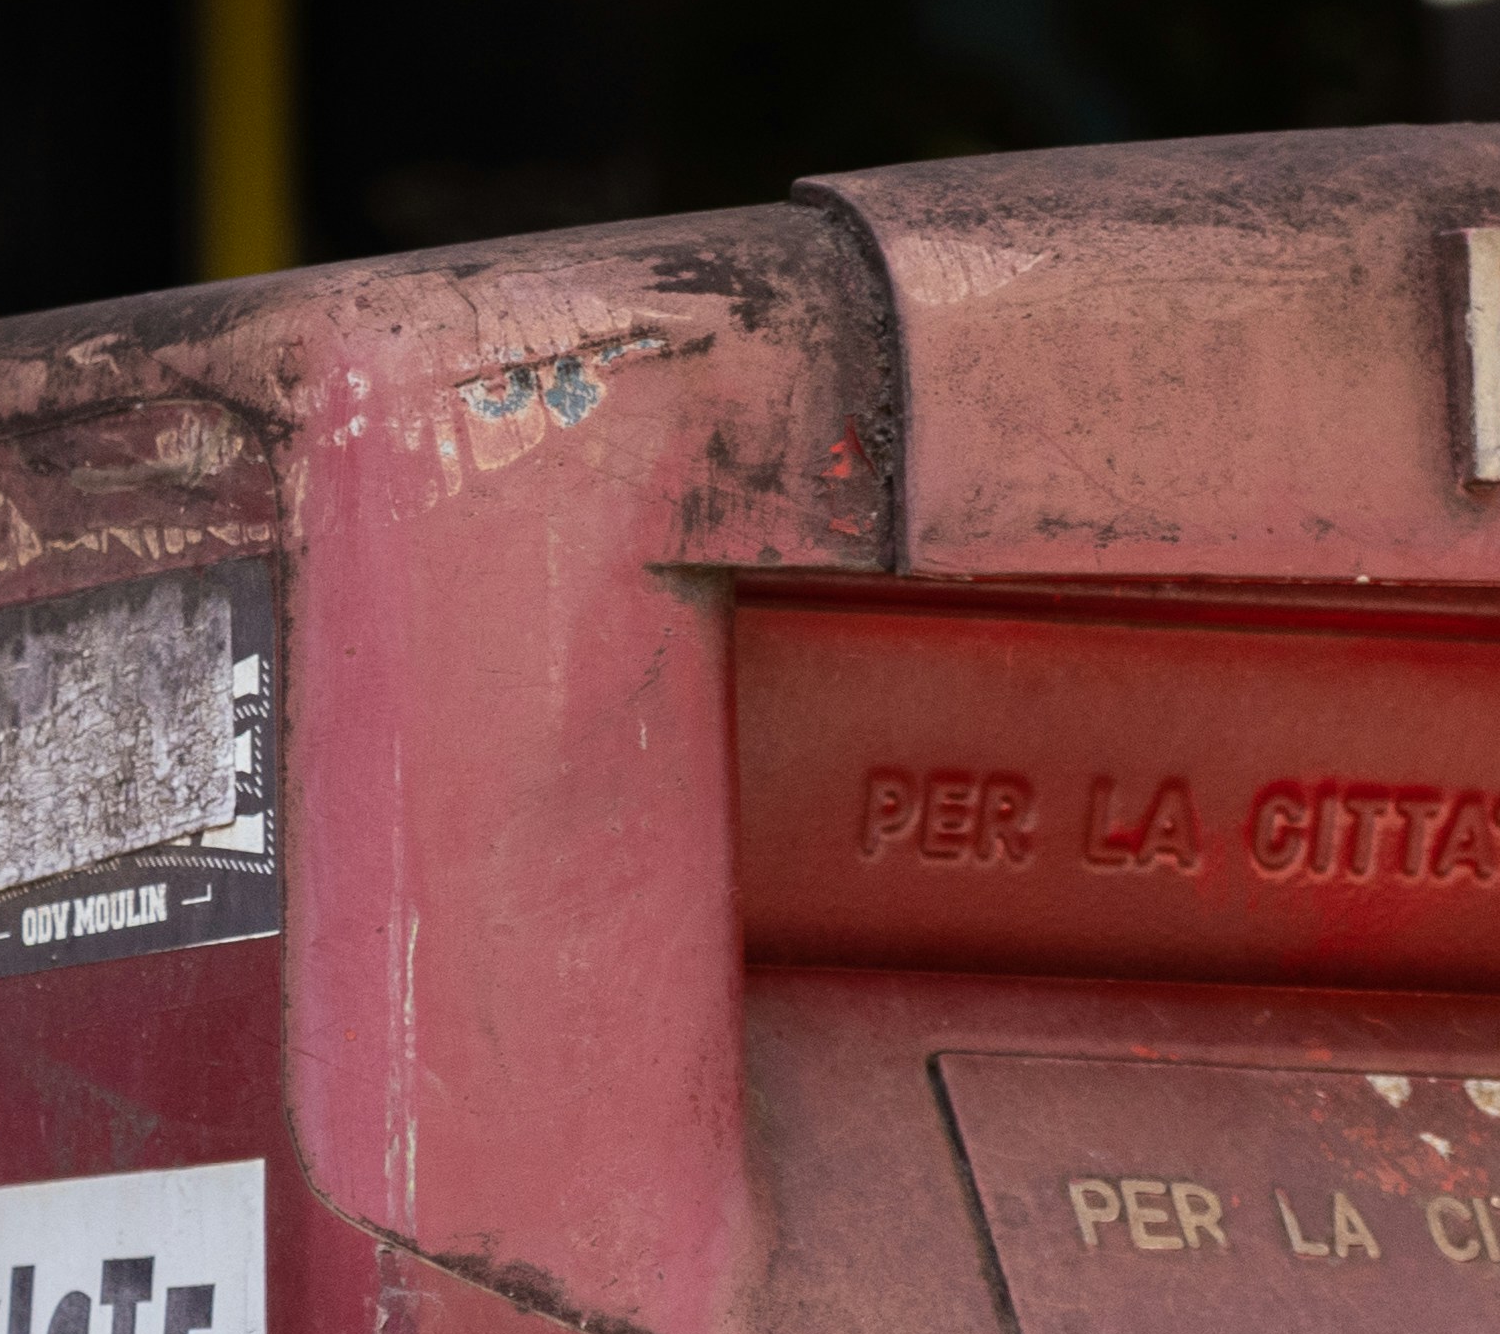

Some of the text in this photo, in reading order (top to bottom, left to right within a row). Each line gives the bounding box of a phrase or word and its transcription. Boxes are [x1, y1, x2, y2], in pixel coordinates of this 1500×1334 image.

[855, 765, 1038, 867] PER
[1082, 772, 1202, 873] LA
[73, 883, 168, 937] MOULIN
[1068, 1178, 1229, 1251] PER
[1275, 1188, 1382, 1259] LA
